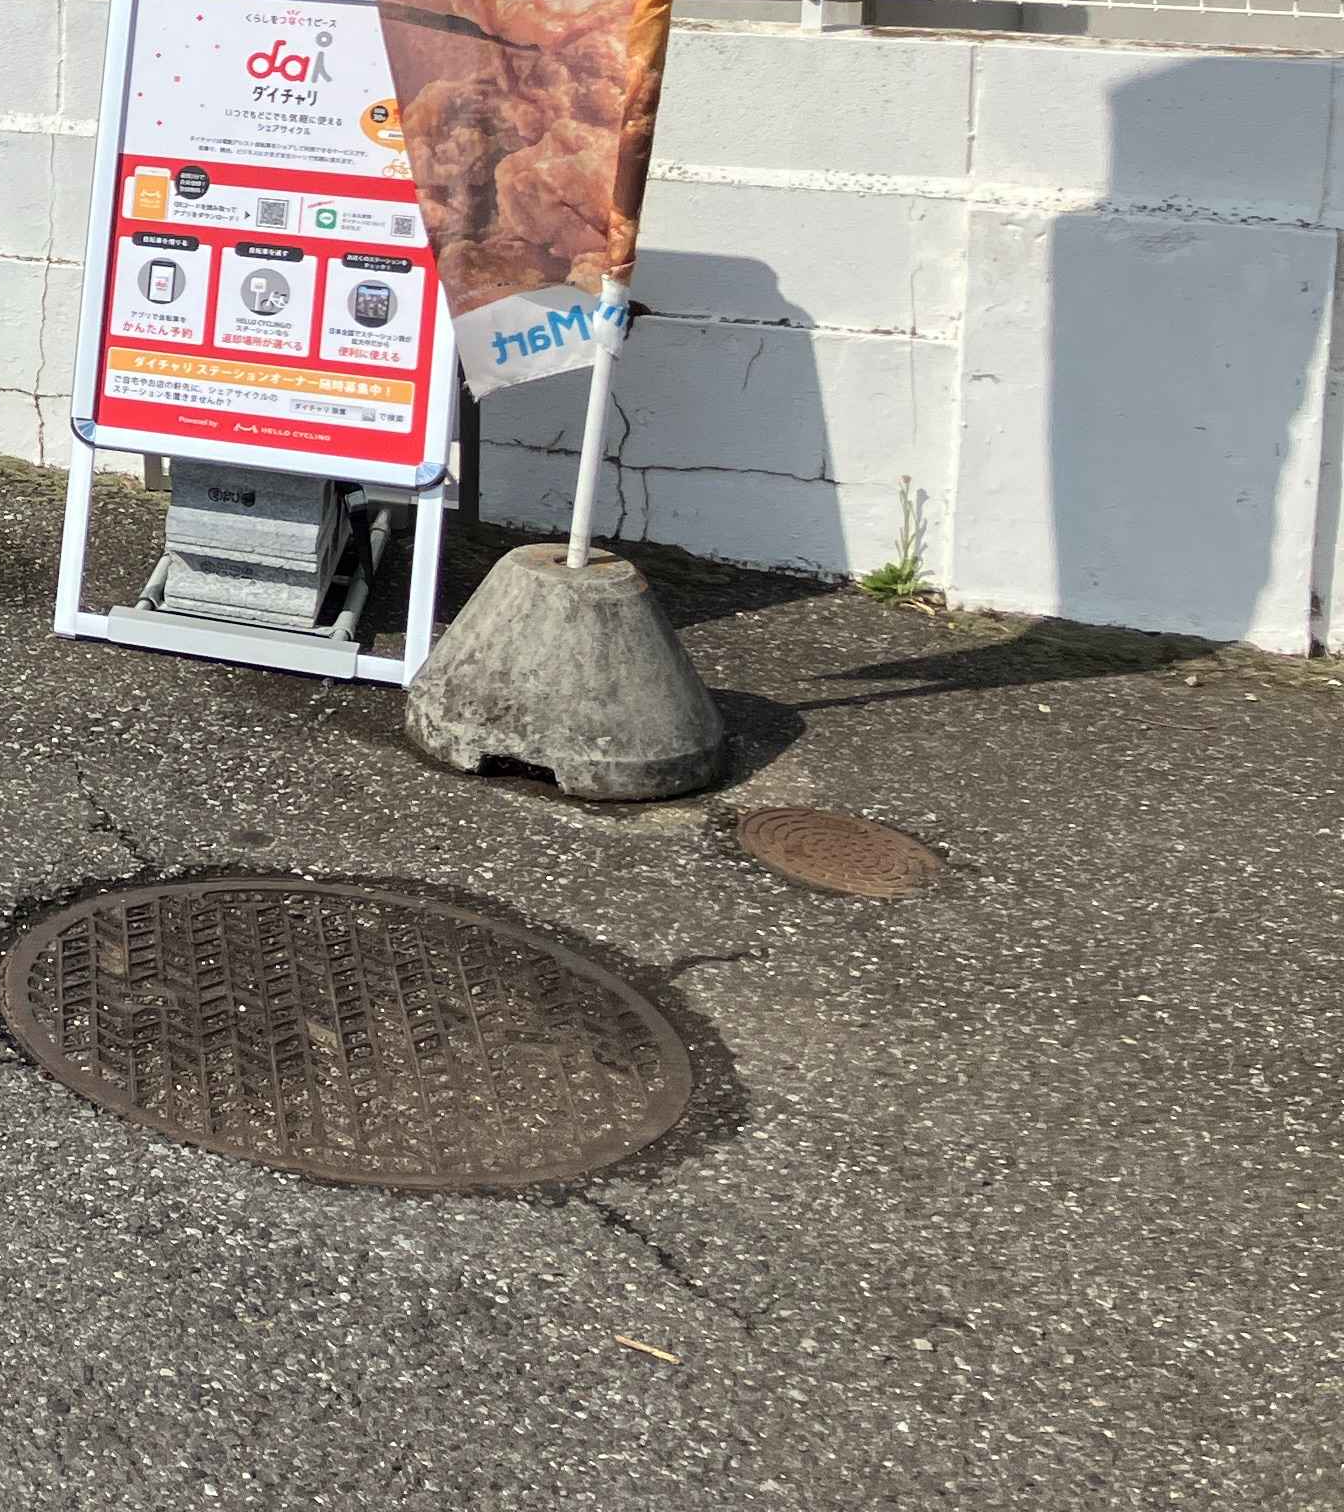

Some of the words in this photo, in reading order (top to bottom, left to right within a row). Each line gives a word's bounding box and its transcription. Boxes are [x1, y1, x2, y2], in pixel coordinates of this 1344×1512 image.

[252, 85, 318, 106] ダイチャリ
[224, 108, 343, 127] いつでもどこでも気軽に使える
[257, 123, 311, 136] シェアサイクル
[122, 321, 193, 339] かんたん予約
[338, 347, 401, 363] 便利に使える
[134, 355, 193, 374] ダイチャリ
[178, 416, 209, 426] Powered
[261, 427, 290, 437] HELLO
[293, 431, 331, 442] CYCLING
